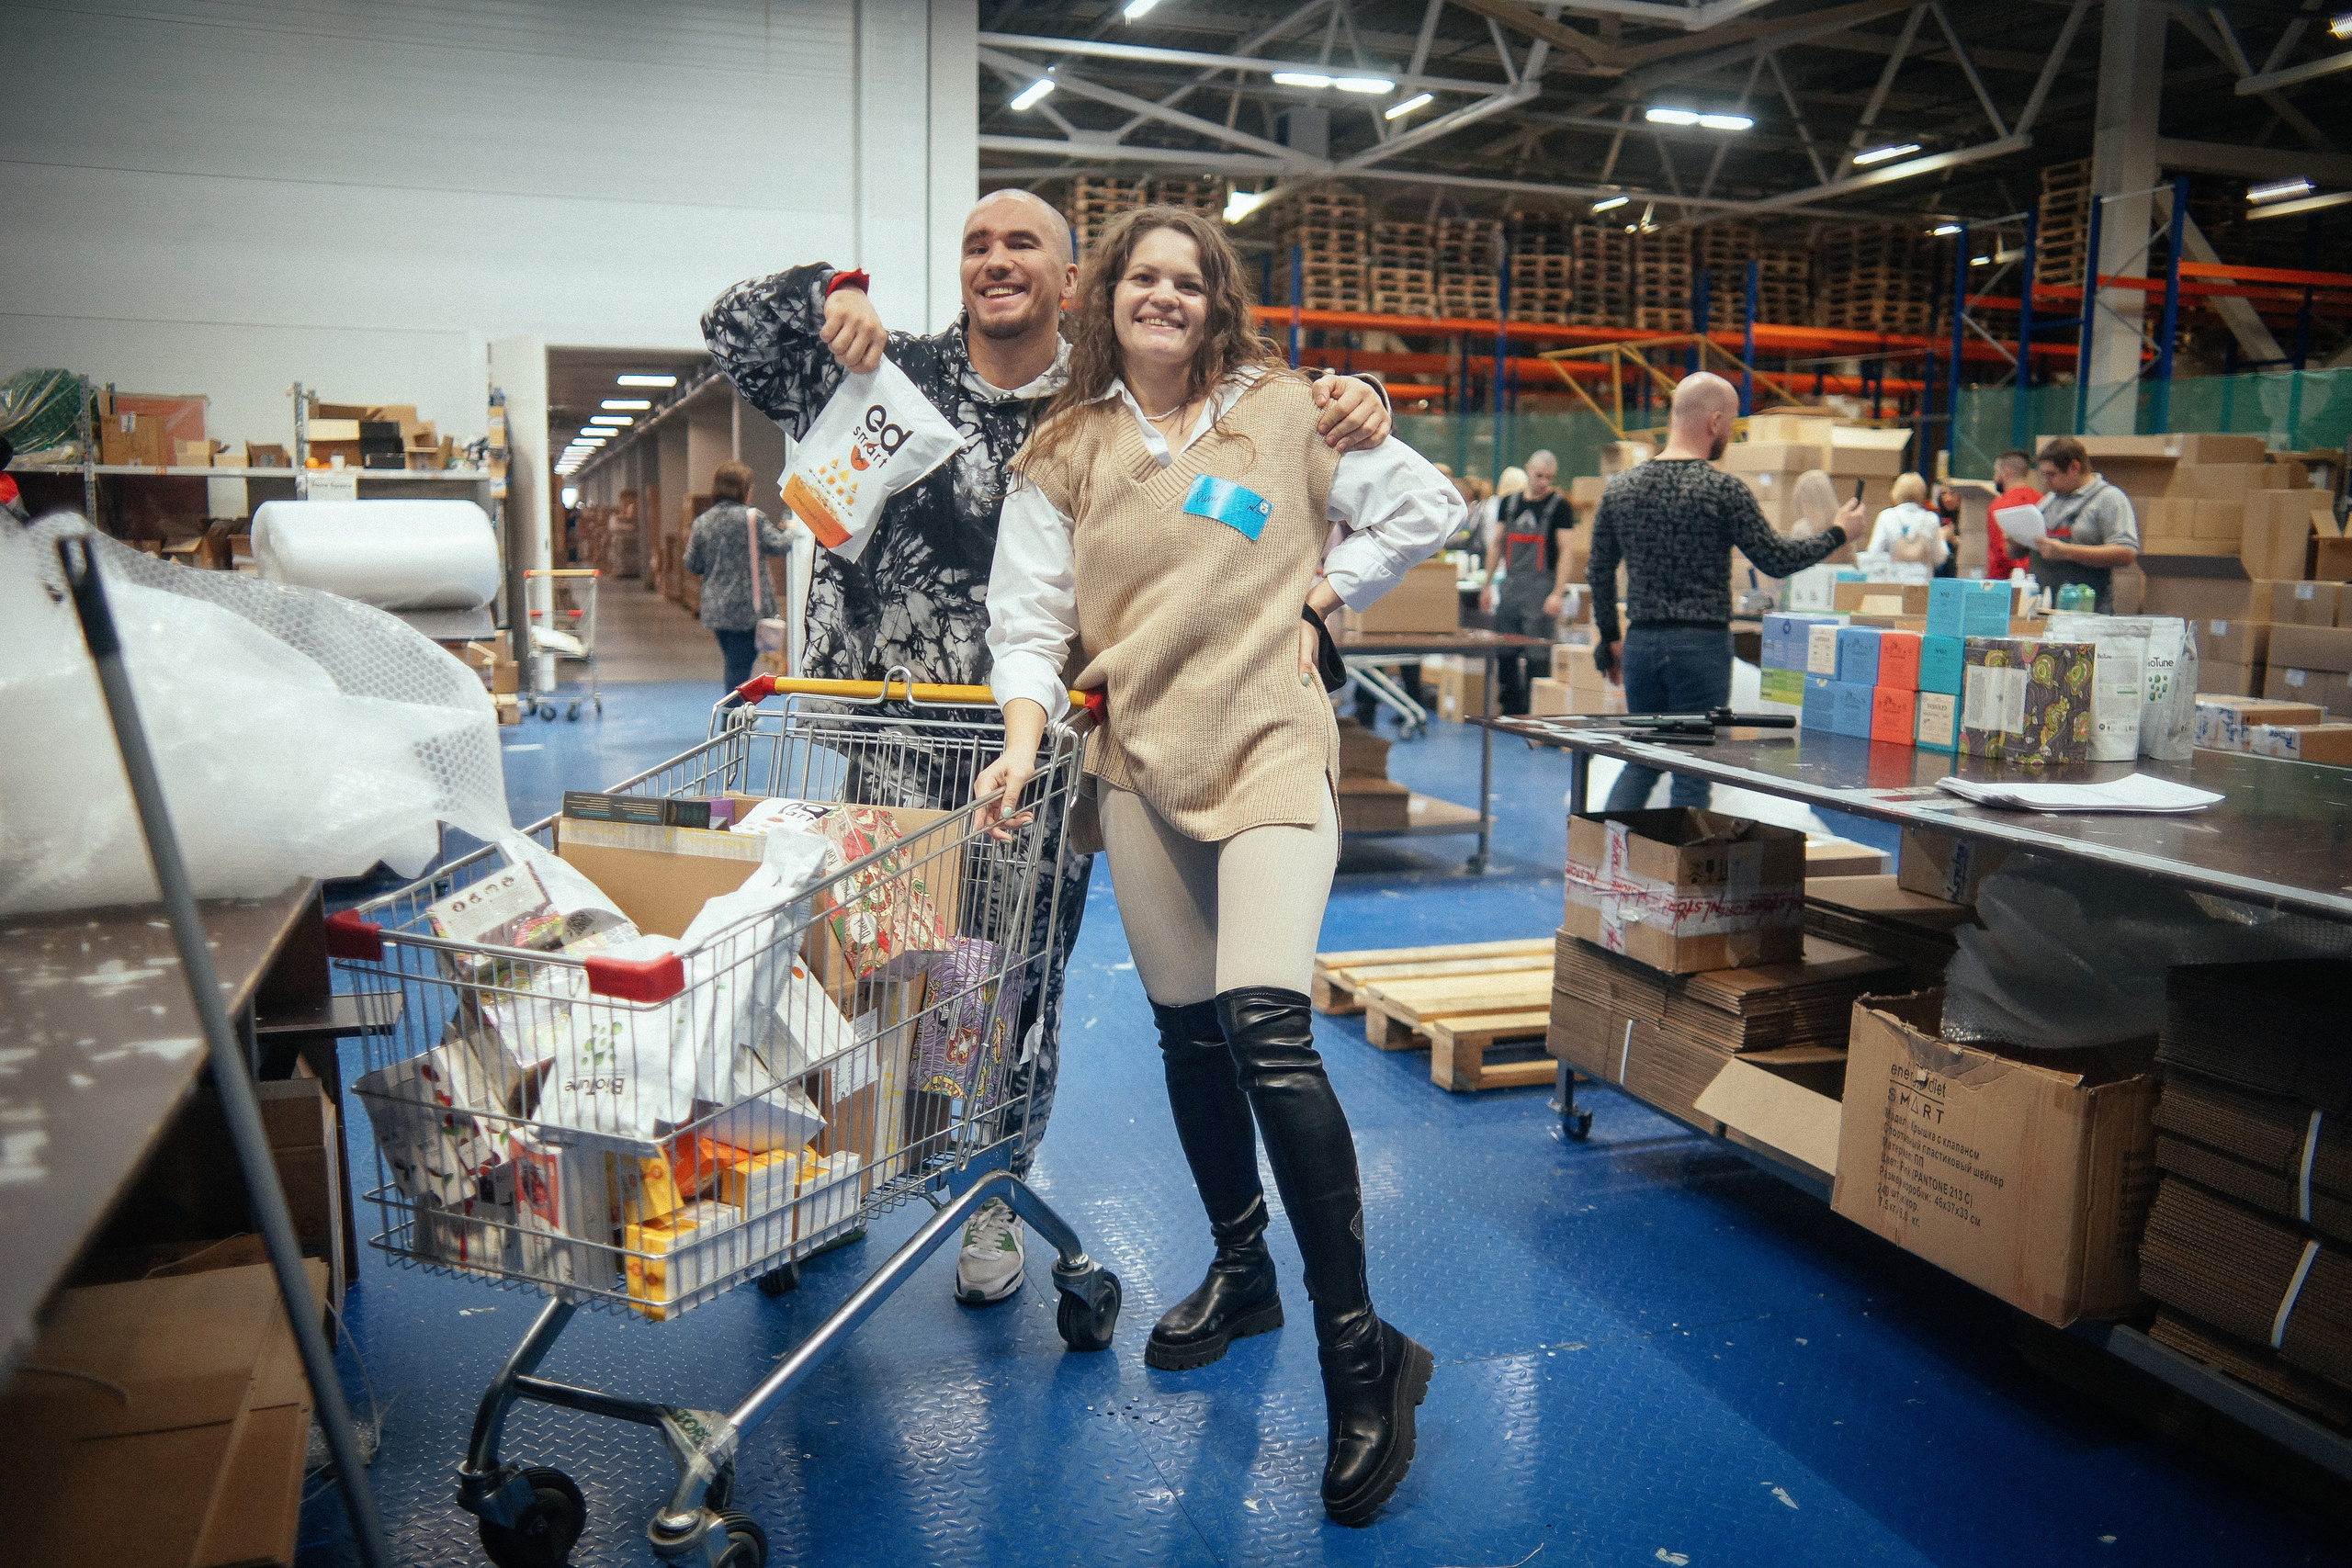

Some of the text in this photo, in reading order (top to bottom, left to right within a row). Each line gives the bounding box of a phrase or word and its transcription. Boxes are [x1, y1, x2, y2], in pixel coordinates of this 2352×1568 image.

[853, 425, 888, 469] smart
[865, 404, 915, 457] ed
[2146, 657, 2175, 668] ioTune
